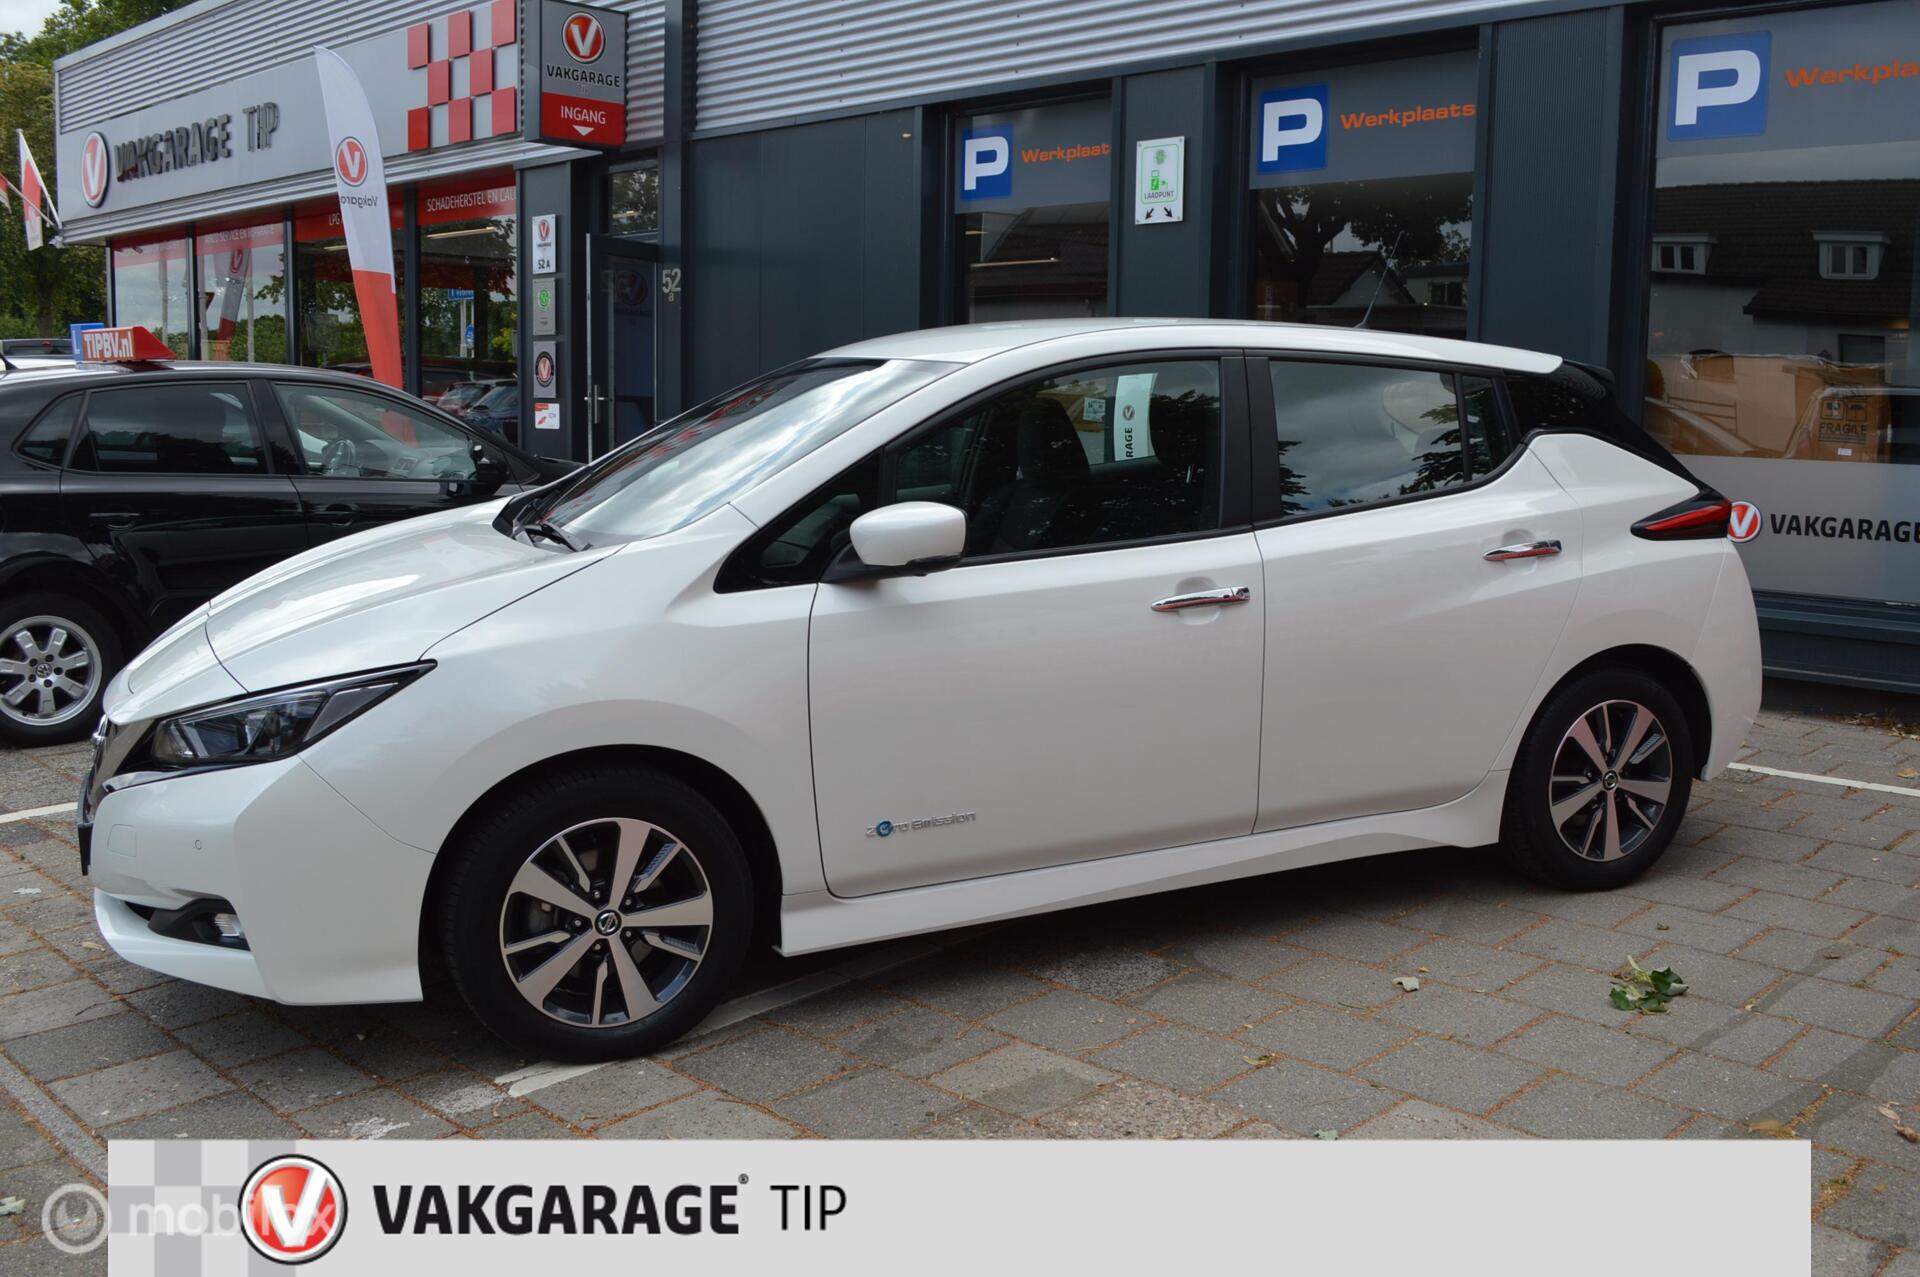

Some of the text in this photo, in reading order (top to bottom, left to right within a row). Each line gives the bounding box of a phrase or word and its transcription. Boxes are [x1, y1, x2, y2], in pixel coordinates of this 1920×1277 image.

[571, 20, 600, 56] V
[547, 64, 620, 88] VAKGARAGE
[1675, 50, 1761, 126] P
[560, 105, 606, 124] INGANG
[113, 113, 232, 183] VAKGARAGE
[242, 101, 280, 152] TIP
[1262, 98, 1476, 163] P Werkplaats
[964, 136, 1112, 191] P Werkplaat
[427, 192, 486, 212] SCHADEHERSTEL
[1144, 190, 1175, 200] LAADPUNT
[662, 268, 682, 293] 52
[668, 292, 675, 302] a
[84, 331, 134, 359] TIPBV.nl
[1819, 422, 1867, 435] FRAGILE
[1124, 427, 1134, 458] RAGE
